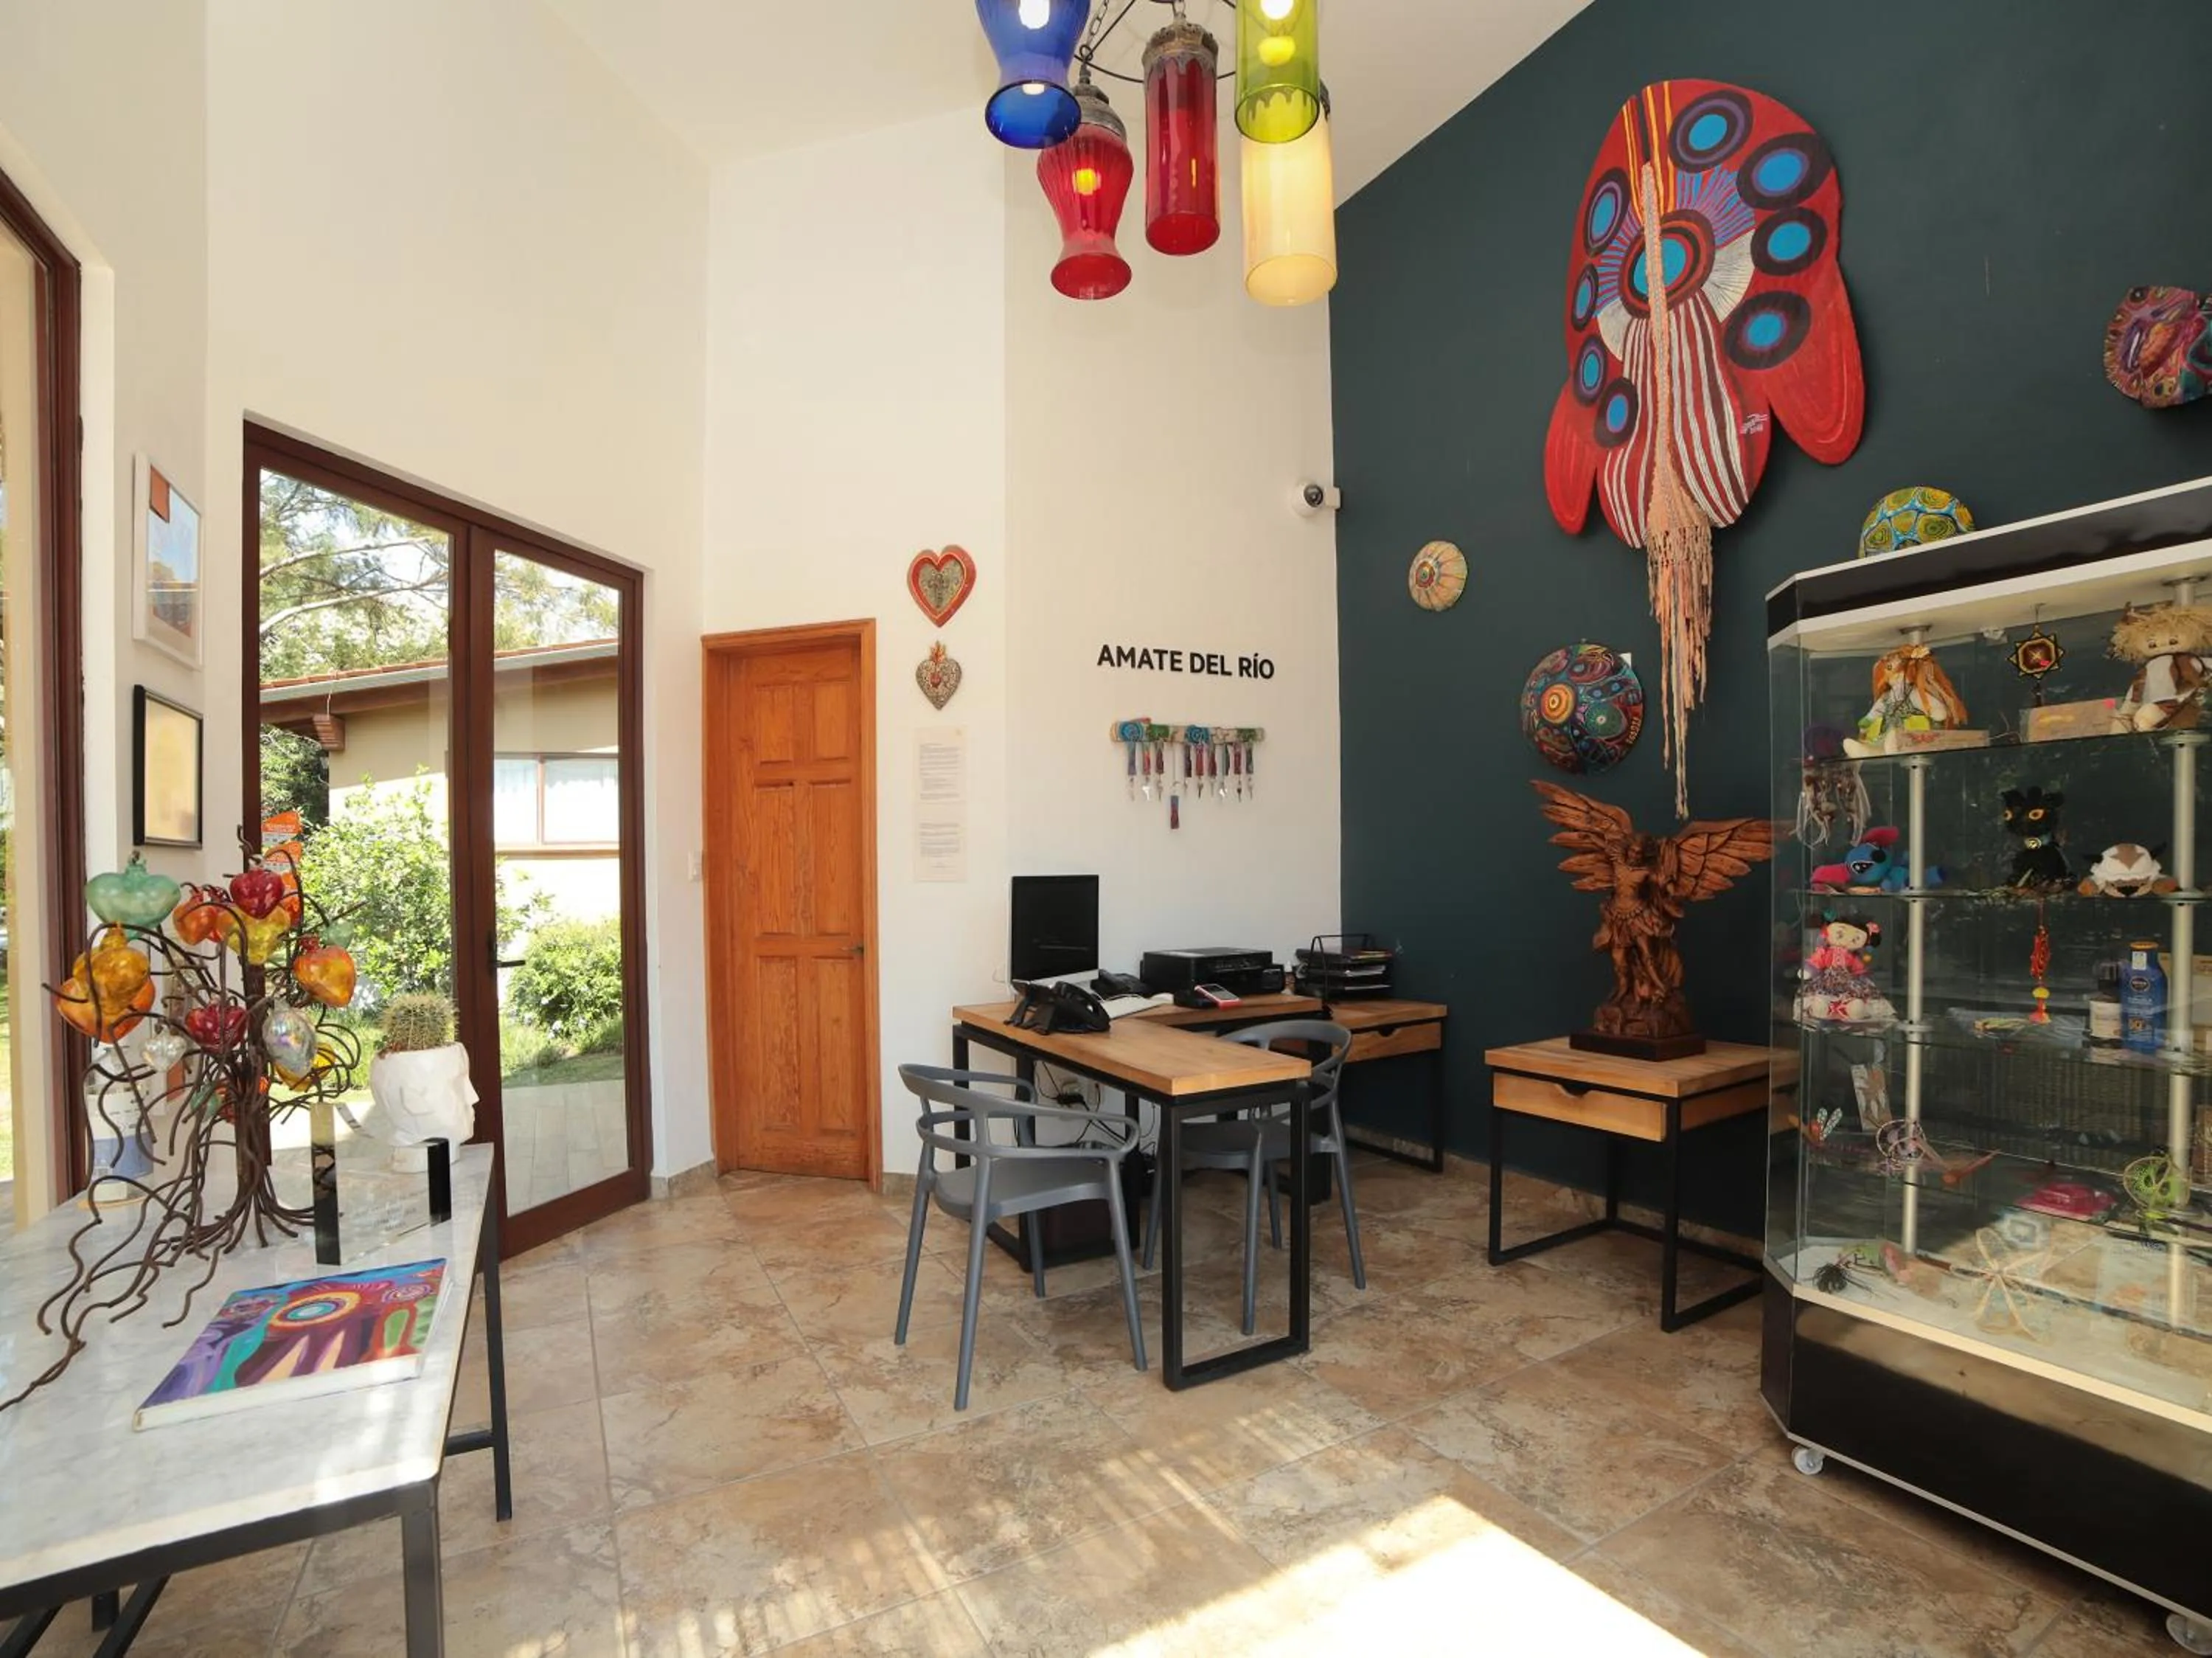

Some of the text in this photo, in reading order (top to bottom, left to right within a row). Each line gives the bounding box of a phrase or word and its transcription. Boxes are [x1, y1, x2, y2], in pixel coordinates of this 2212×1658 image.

[1097, 644, 1275, 679] AMATE DEL RÍO
